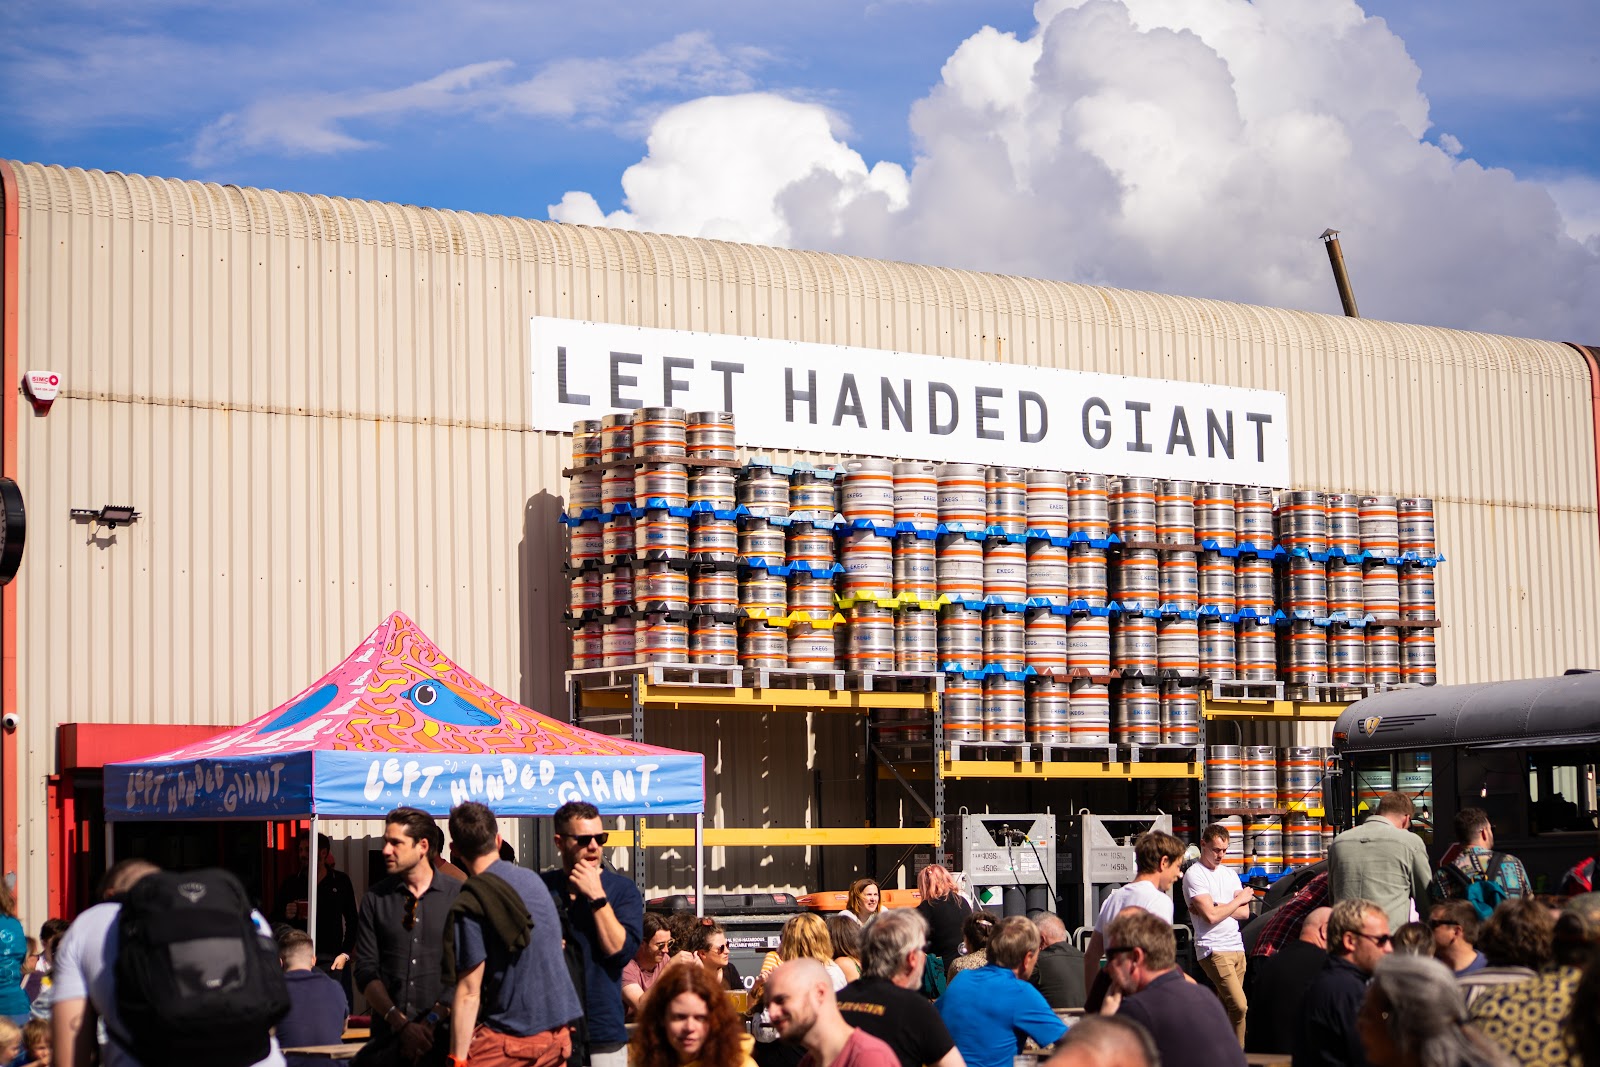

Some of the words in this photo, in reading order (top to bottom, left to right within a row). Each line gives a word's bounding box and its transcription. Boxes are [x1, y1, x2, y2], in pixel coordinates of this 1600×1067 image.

[557, 346, 745, 412] LEFT
[785, 367, 1048, 443] HANDED
[1082, 397, 1272, 462] GIANT
[126, 768, 166, 810] LEFT
[168, 763, 225, 814] HANDED
[223, 762, 285, 813] GIANT
[363, 758, 444, 802] LEFT
[450, 758, 556, 807] HANDED
[558, 763, 660, 804] GIANT
